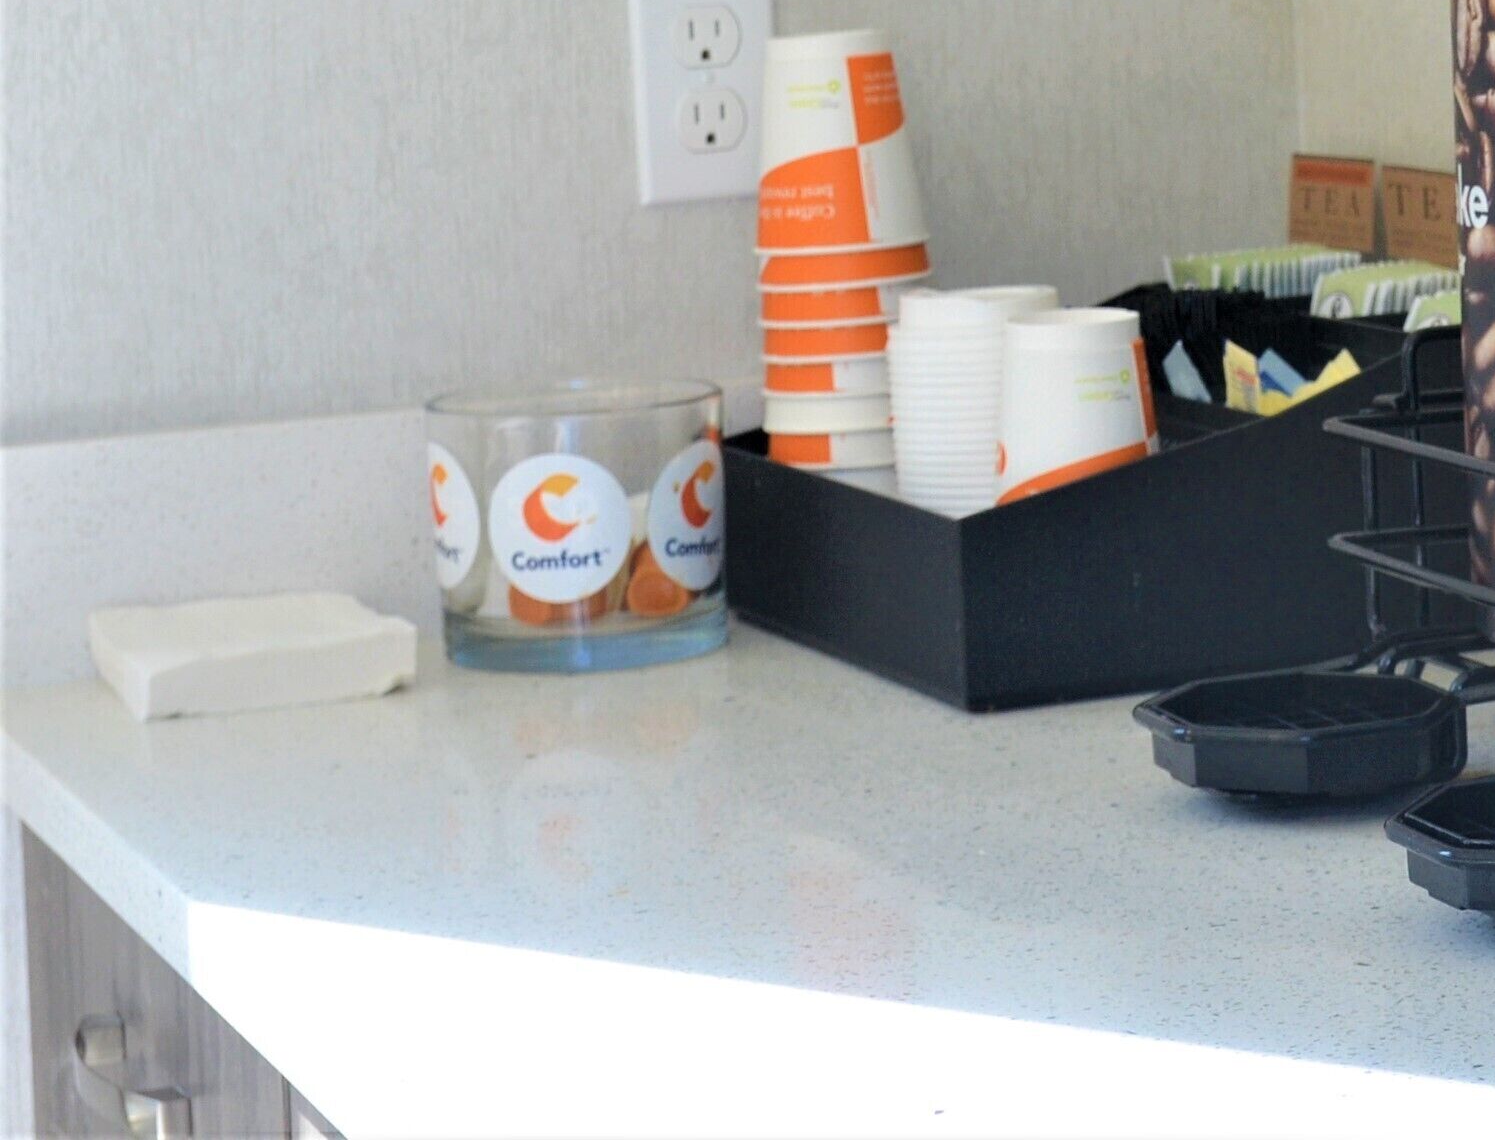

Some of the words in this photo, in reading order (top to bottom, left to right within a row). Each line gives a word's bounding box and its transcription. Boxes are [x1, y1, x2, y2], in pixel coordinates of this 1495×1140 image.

[1302, 186, 1360, 217] TEA
[1388, 182, 1441, 221] TE
[1455, 162, 1489, 230] ke
[512, 548, 601, 571] Comfort
